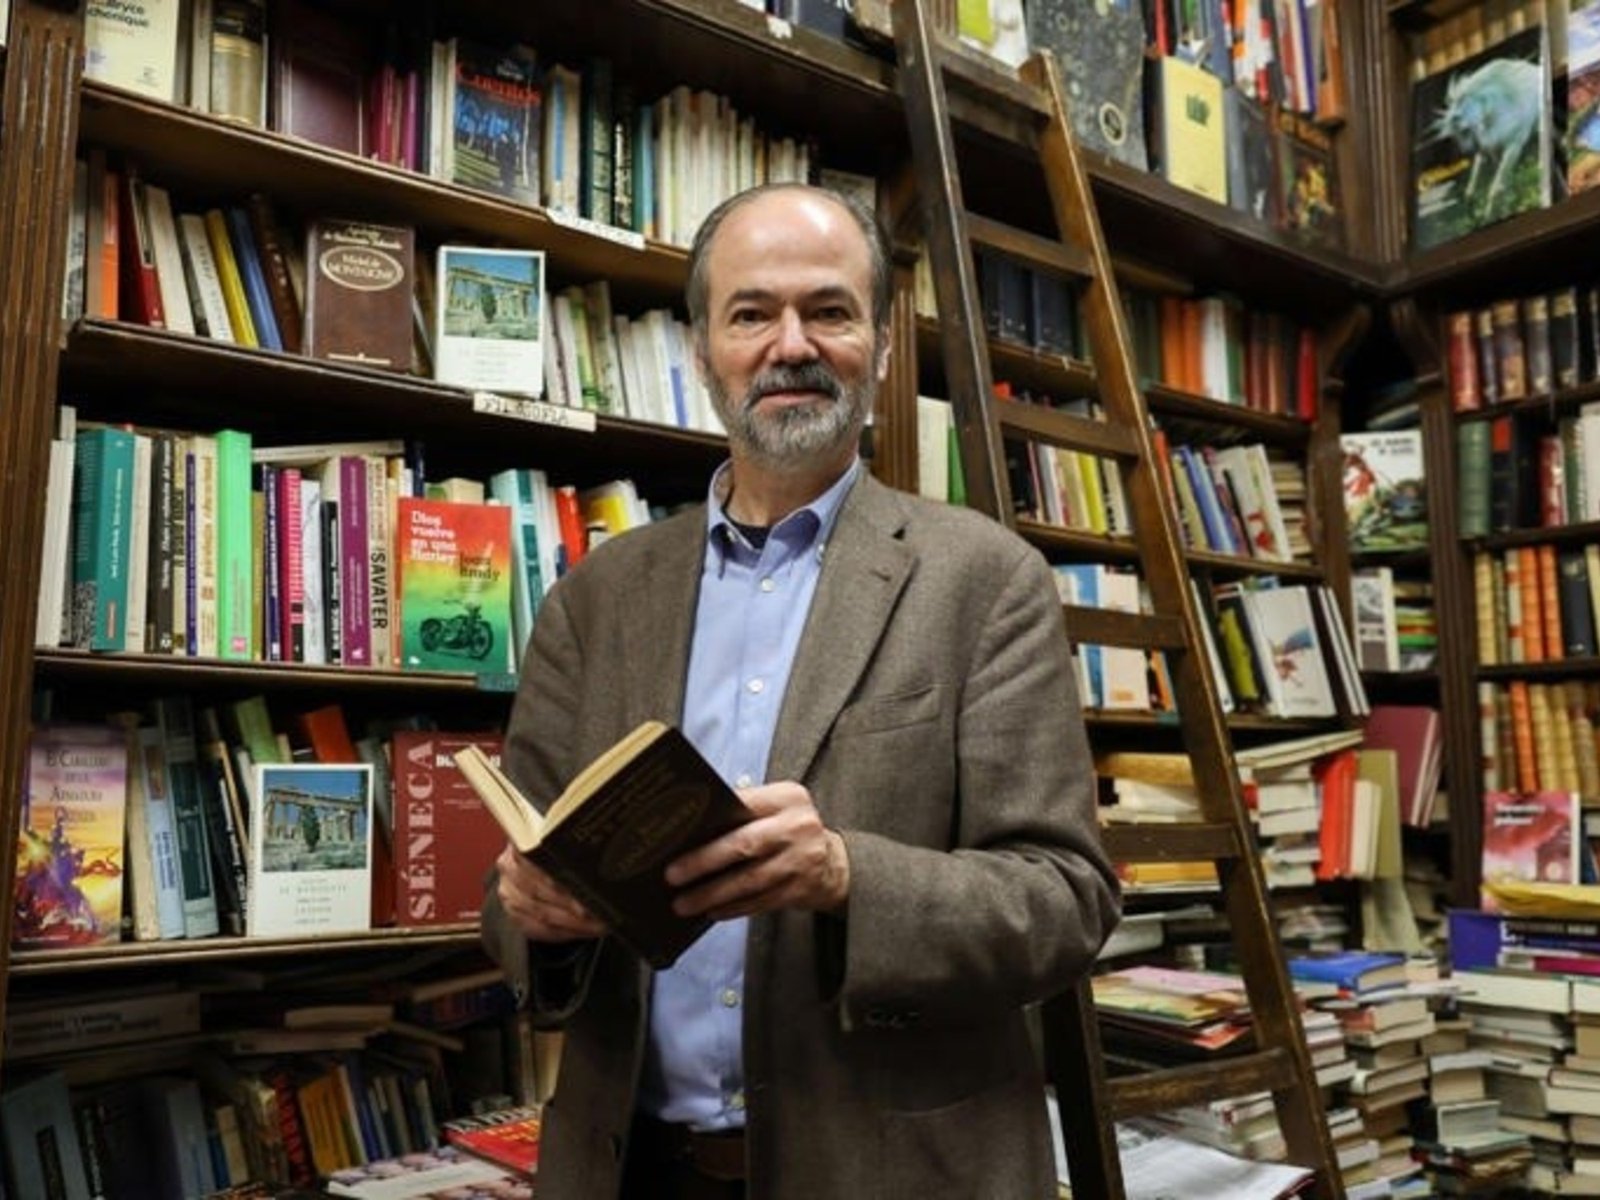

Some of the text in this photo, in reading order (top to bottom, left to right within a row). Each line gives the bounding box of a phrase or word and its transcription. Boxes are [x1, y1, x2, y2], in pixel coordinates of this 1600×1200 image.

[411, 510, 442, 526] Dios
[370, 551, 388, 629] SAVATER
[400, 741, 436, 920] SÉNECA
